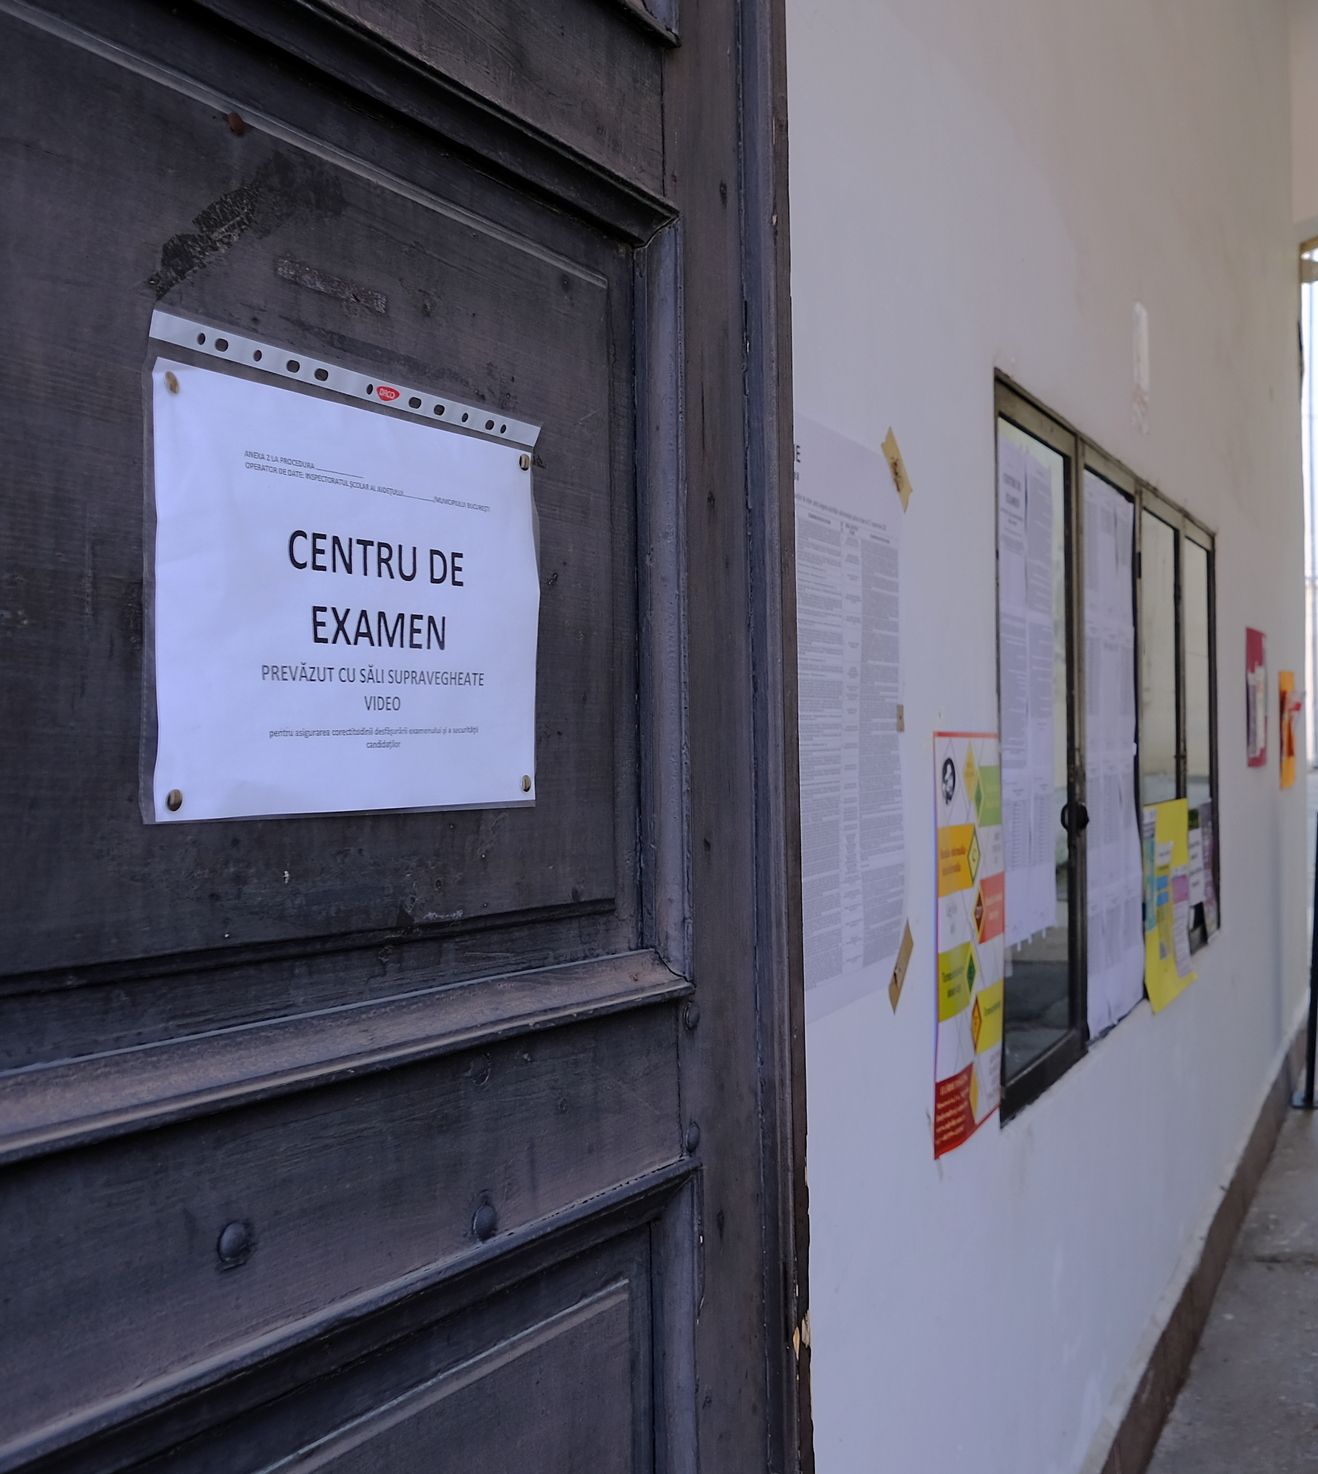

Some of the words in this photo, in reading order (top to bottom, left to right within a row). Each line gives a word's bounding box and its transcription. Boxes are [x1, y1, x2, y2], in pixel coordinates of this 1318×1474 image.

[244, 450, 265, 460] ANEXA
[271, 455, 279, 463] LA
[245, 461, 278, 474] OPERATOR
[278, 467, 287, 476] DE
[288, 529, 417, 582] CENTRU
[429, 548, 464, 587] DE
[312, 605, 446, 650] EXAMEN
[261, 662, 334, 682] PREVĂZUT
[338, 667, 356, 683] CU
[359, 664, 384, 684] SĂLI
[388, 668, 485, 687] SUPRAVEGHEATE
[364, 695, 401, 711] VIDEO
[269, 728, 293, 739] pentru
[295, 728, 330, 739] asigurarea
